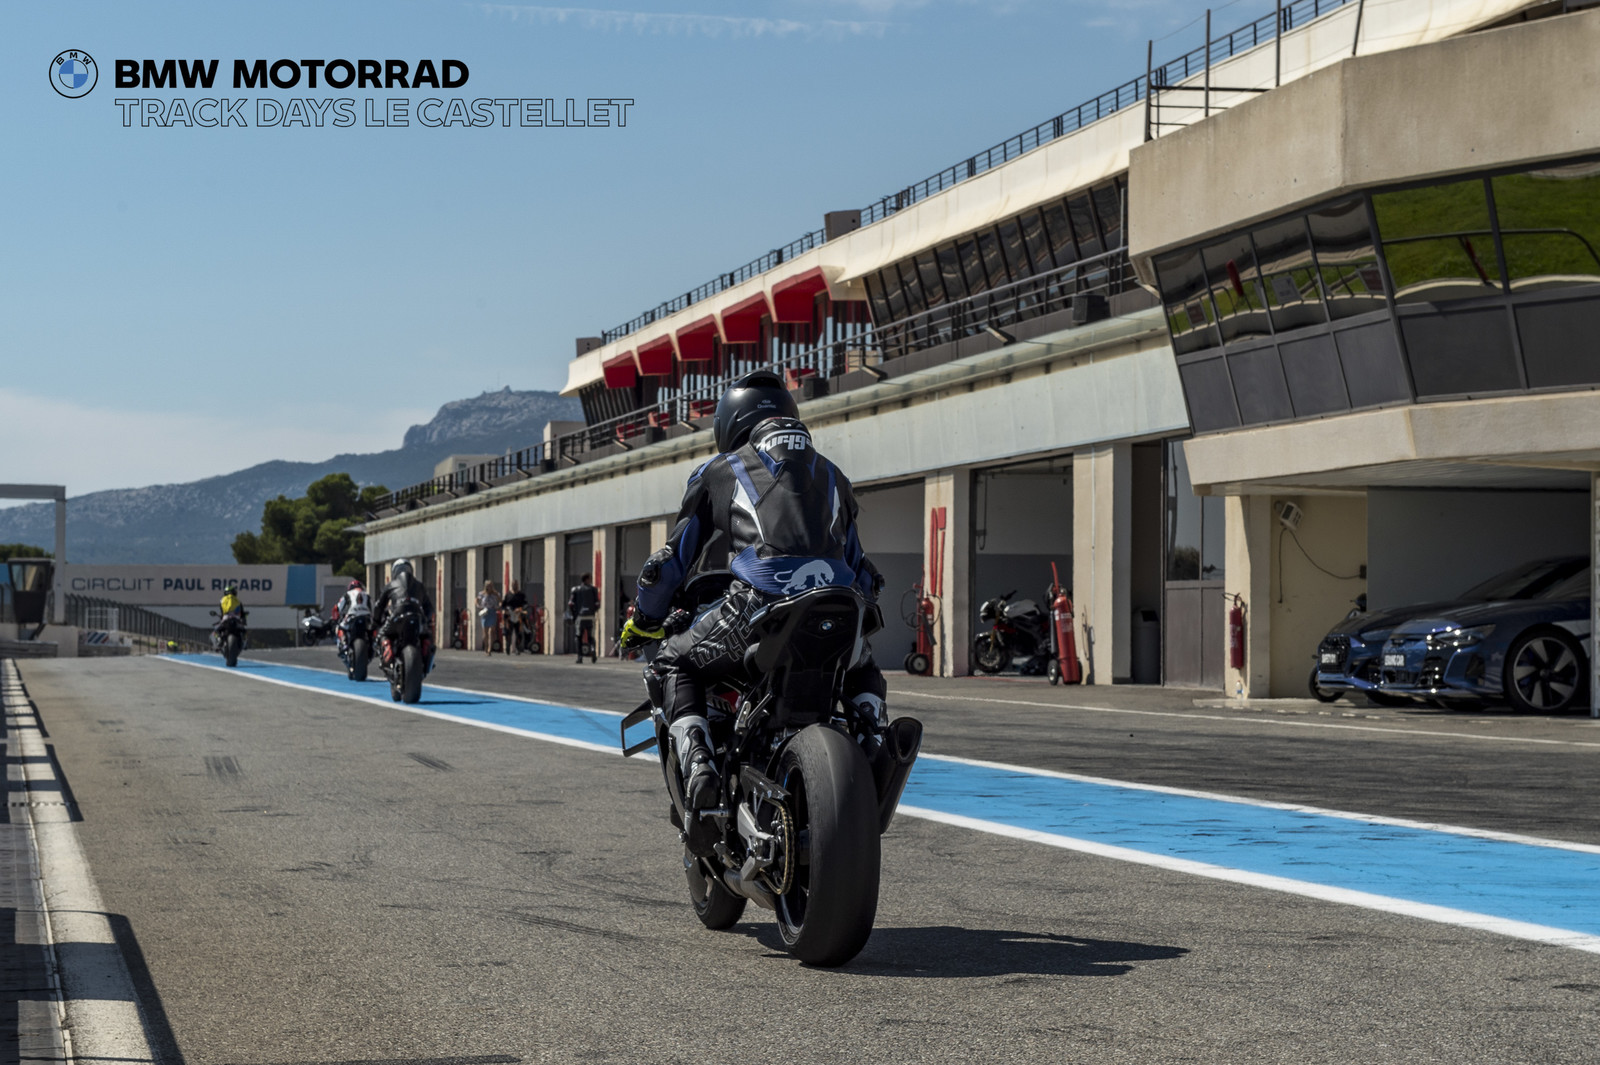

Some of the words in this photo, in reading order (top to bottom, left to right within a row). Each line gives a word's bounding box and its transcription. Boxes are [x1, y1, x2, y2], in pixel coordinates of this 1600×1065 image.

[71, 577, 155, 591] CIRCUIT
[163, 578, 205, 591] PAUL
[211, 578, 273, 591] RICARD
